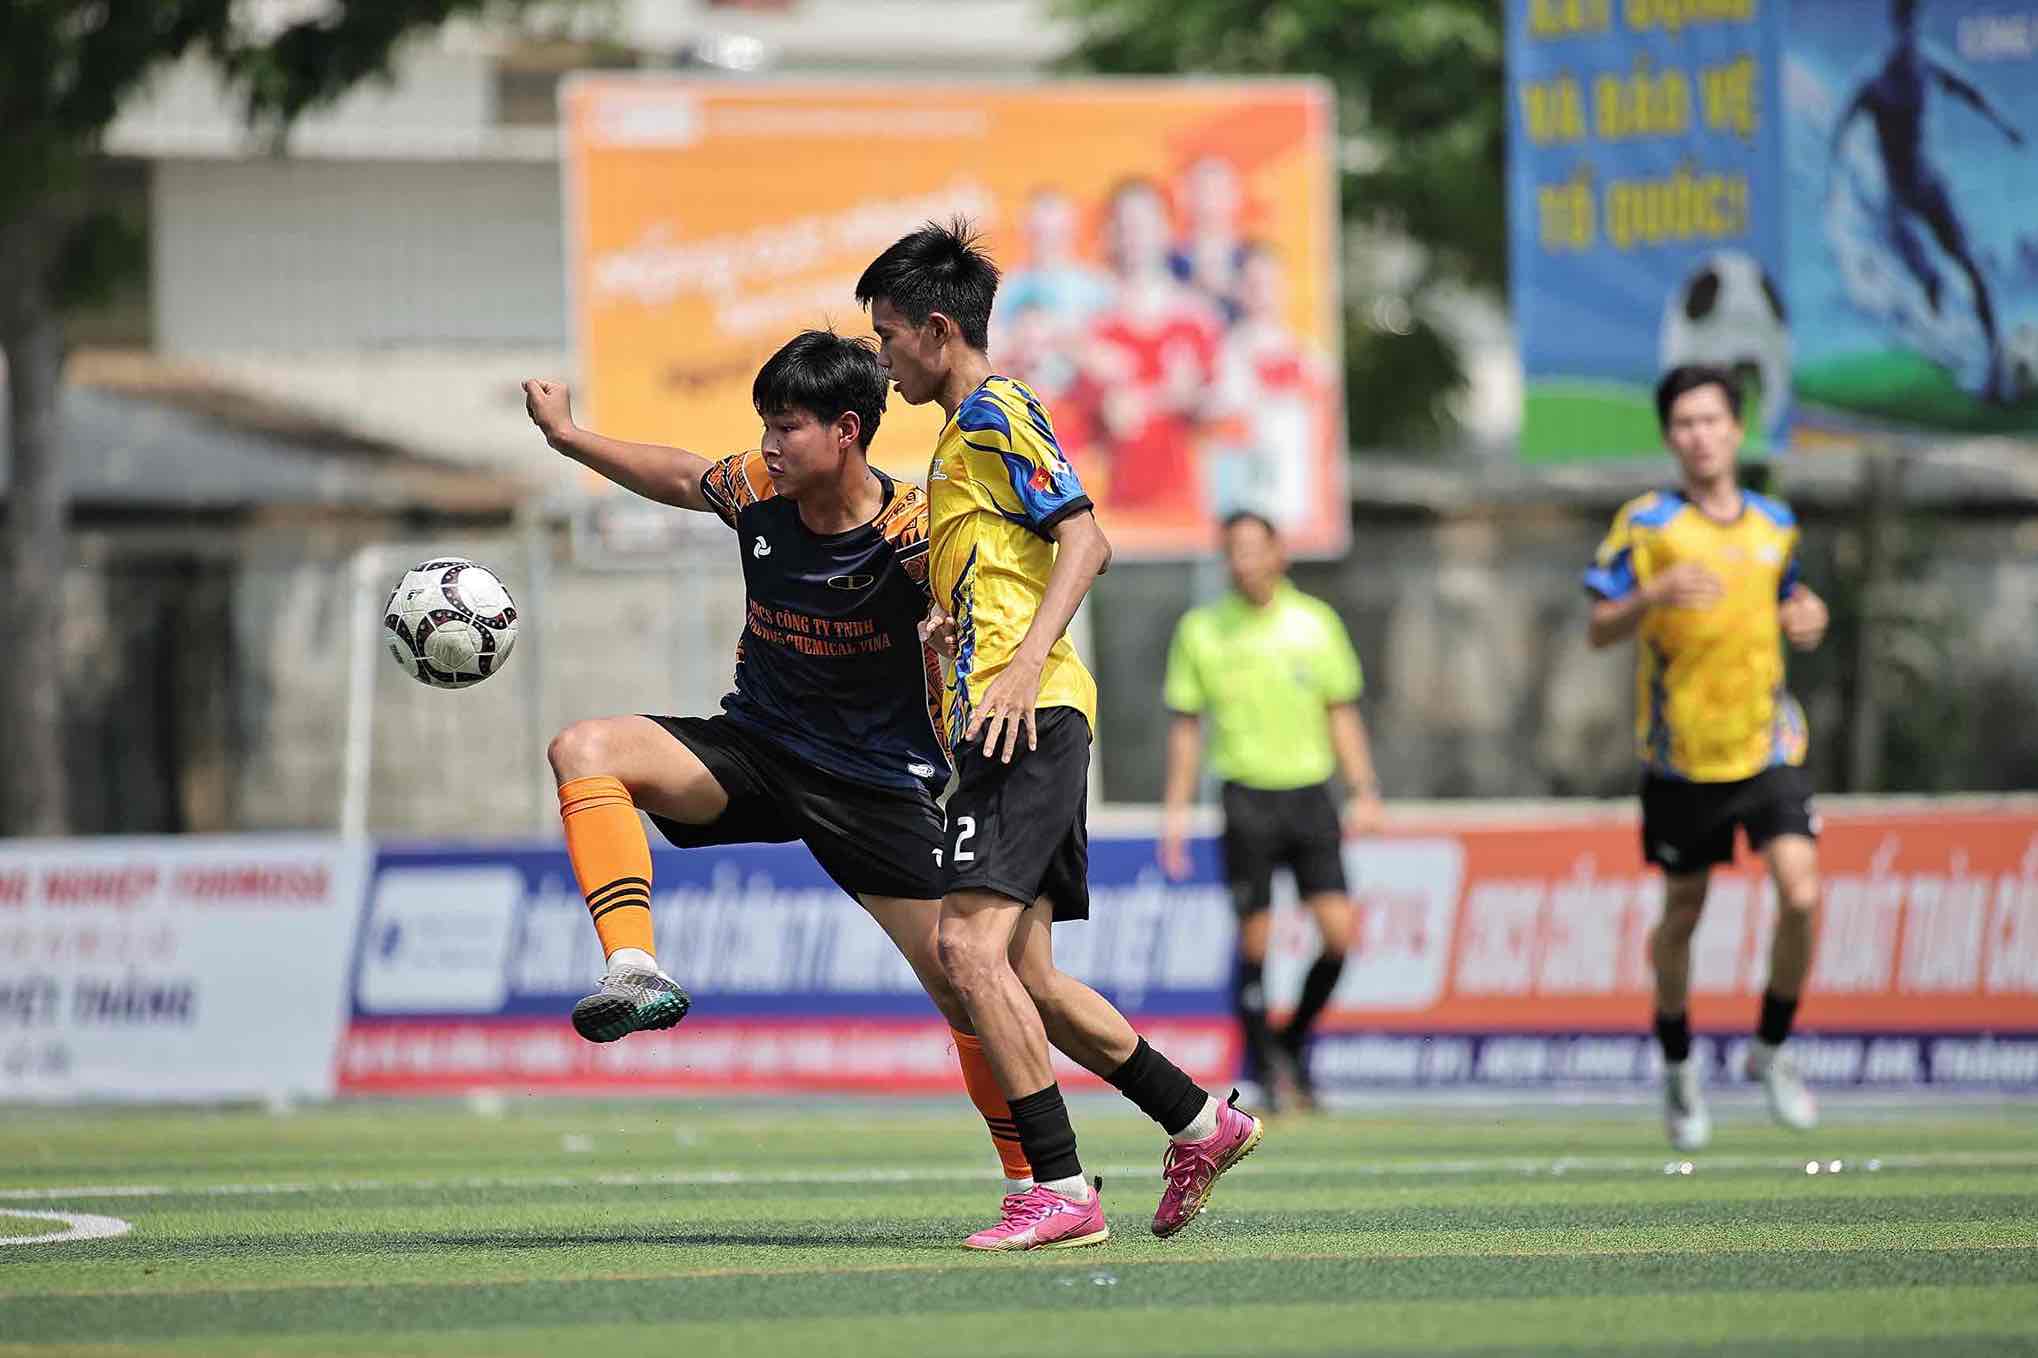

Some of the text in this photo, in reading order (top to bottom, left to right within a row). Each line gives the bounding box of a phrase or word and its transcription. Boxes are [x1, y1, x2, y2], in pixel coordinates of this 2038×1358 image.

[776, 609, 810, 634] CÔNG
[813, 618, 831, 638] TY
[833, 618, 875, 641] TNHH
[786, 633, 856, 657] CHEMICAL
[858, 631, 892, 654] VINA
[954, 815, 976, 862] 2
